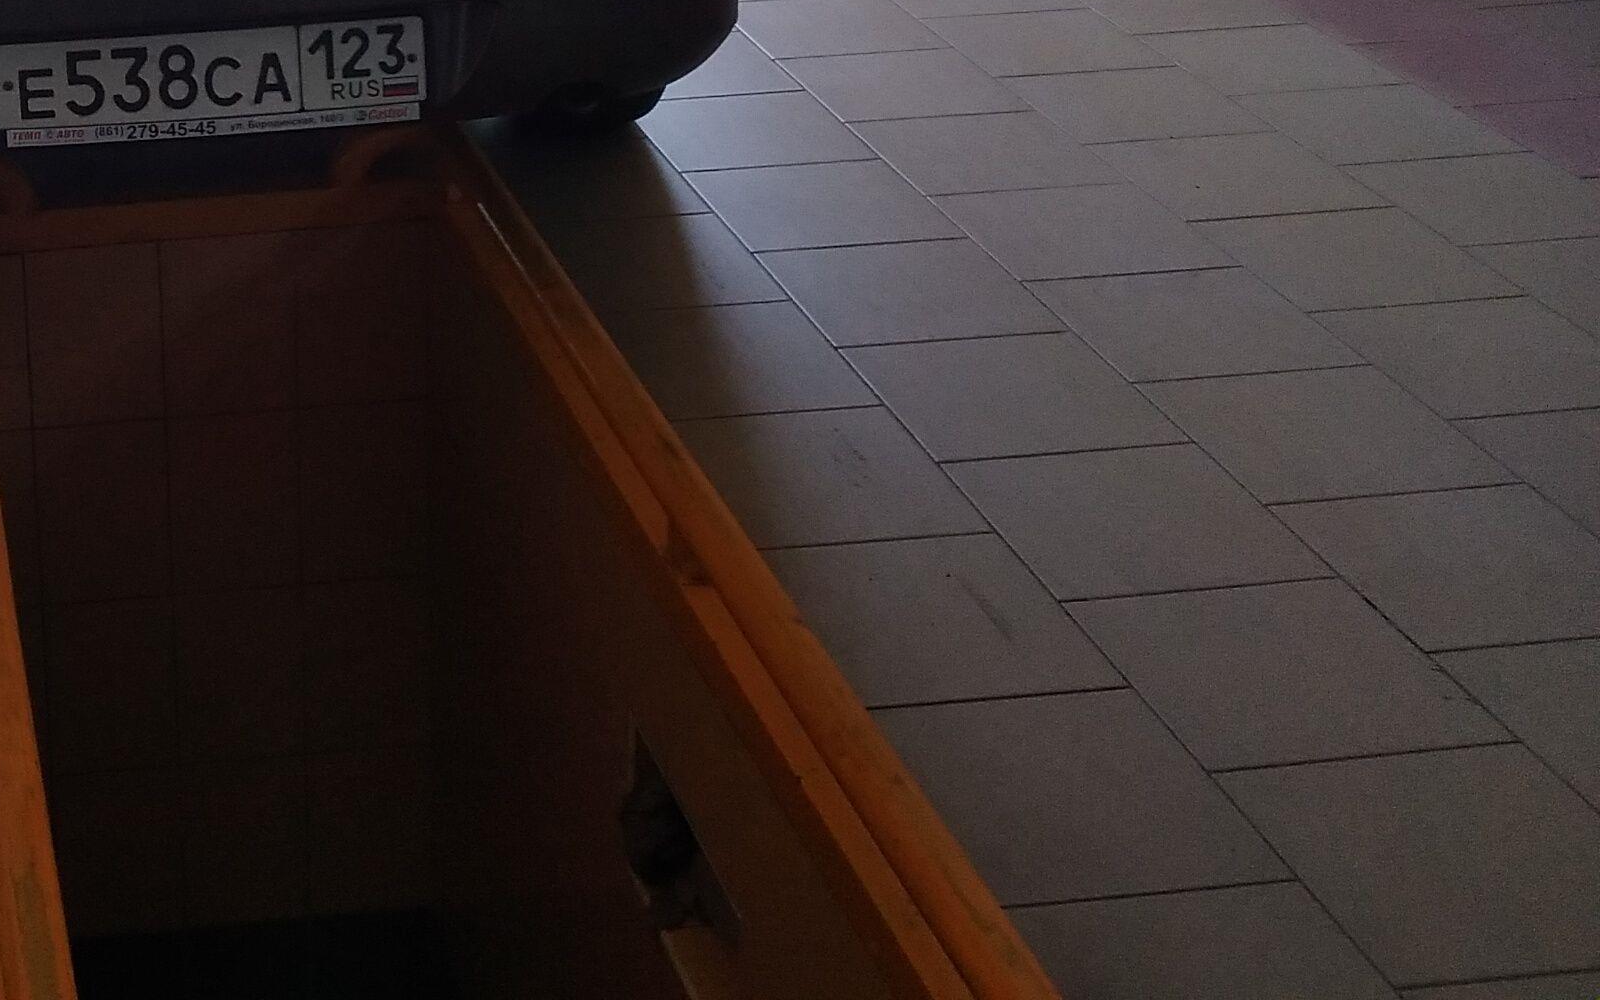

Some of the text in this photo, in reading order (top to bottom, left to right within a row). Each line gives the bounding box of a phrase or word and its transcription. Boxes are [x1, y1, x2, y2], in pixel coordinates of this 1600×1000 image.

[308, 24, 405, 81] 123
[330, 79, 382, 100] RUS
[126, 120, 217, 140] 279-45-45
